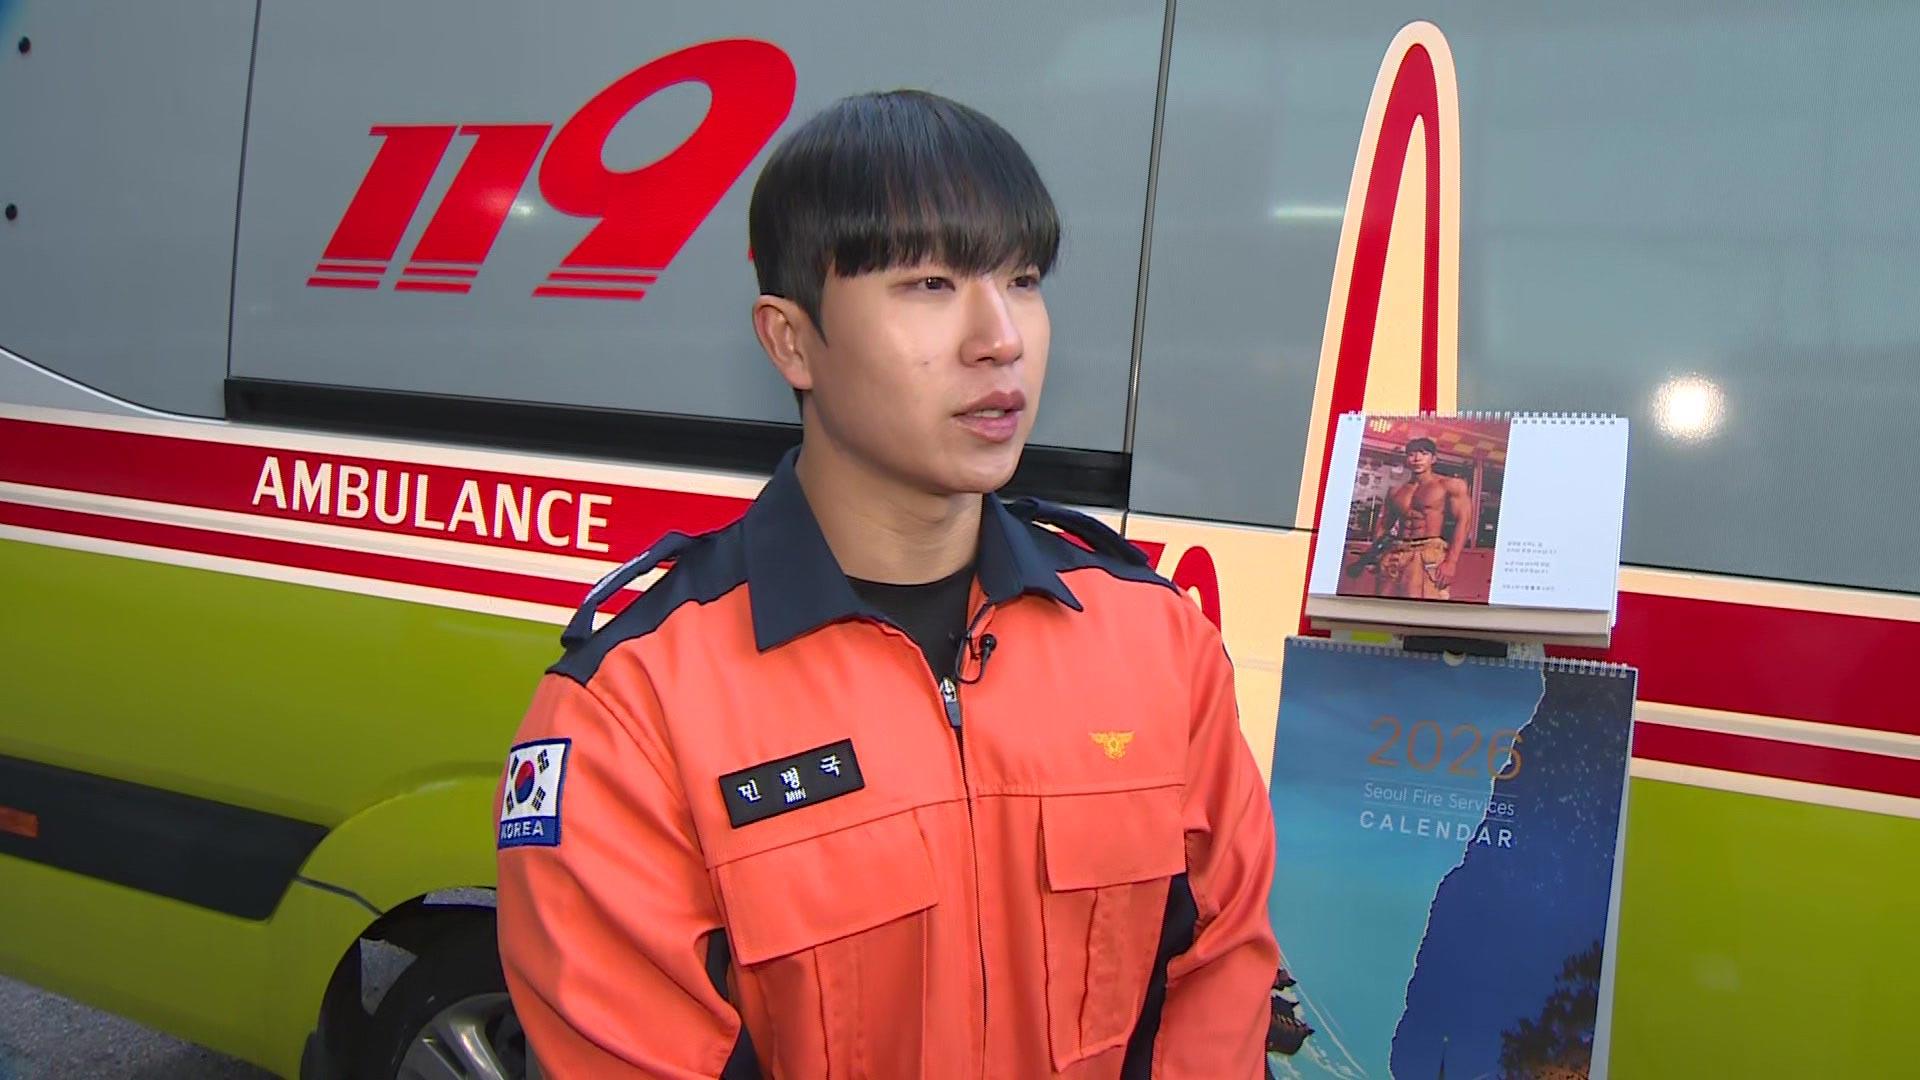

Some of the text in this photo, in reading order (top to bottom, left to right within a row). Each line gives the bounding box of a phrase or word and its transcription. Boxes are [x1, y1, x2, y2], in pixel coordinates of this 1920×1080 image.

[306, 37, 797, 300] 119
[253, 456, 612, 552] AMBULANCE
[1368, 715, 1523, 780] 2026
[784, 787, 807, 803] MIN
[1364, 782, 1515, 816] Seoul Fire Services
[500, 820, 544, 840] KOREA
[1360, 811, 1513, 848] CALENDAR
